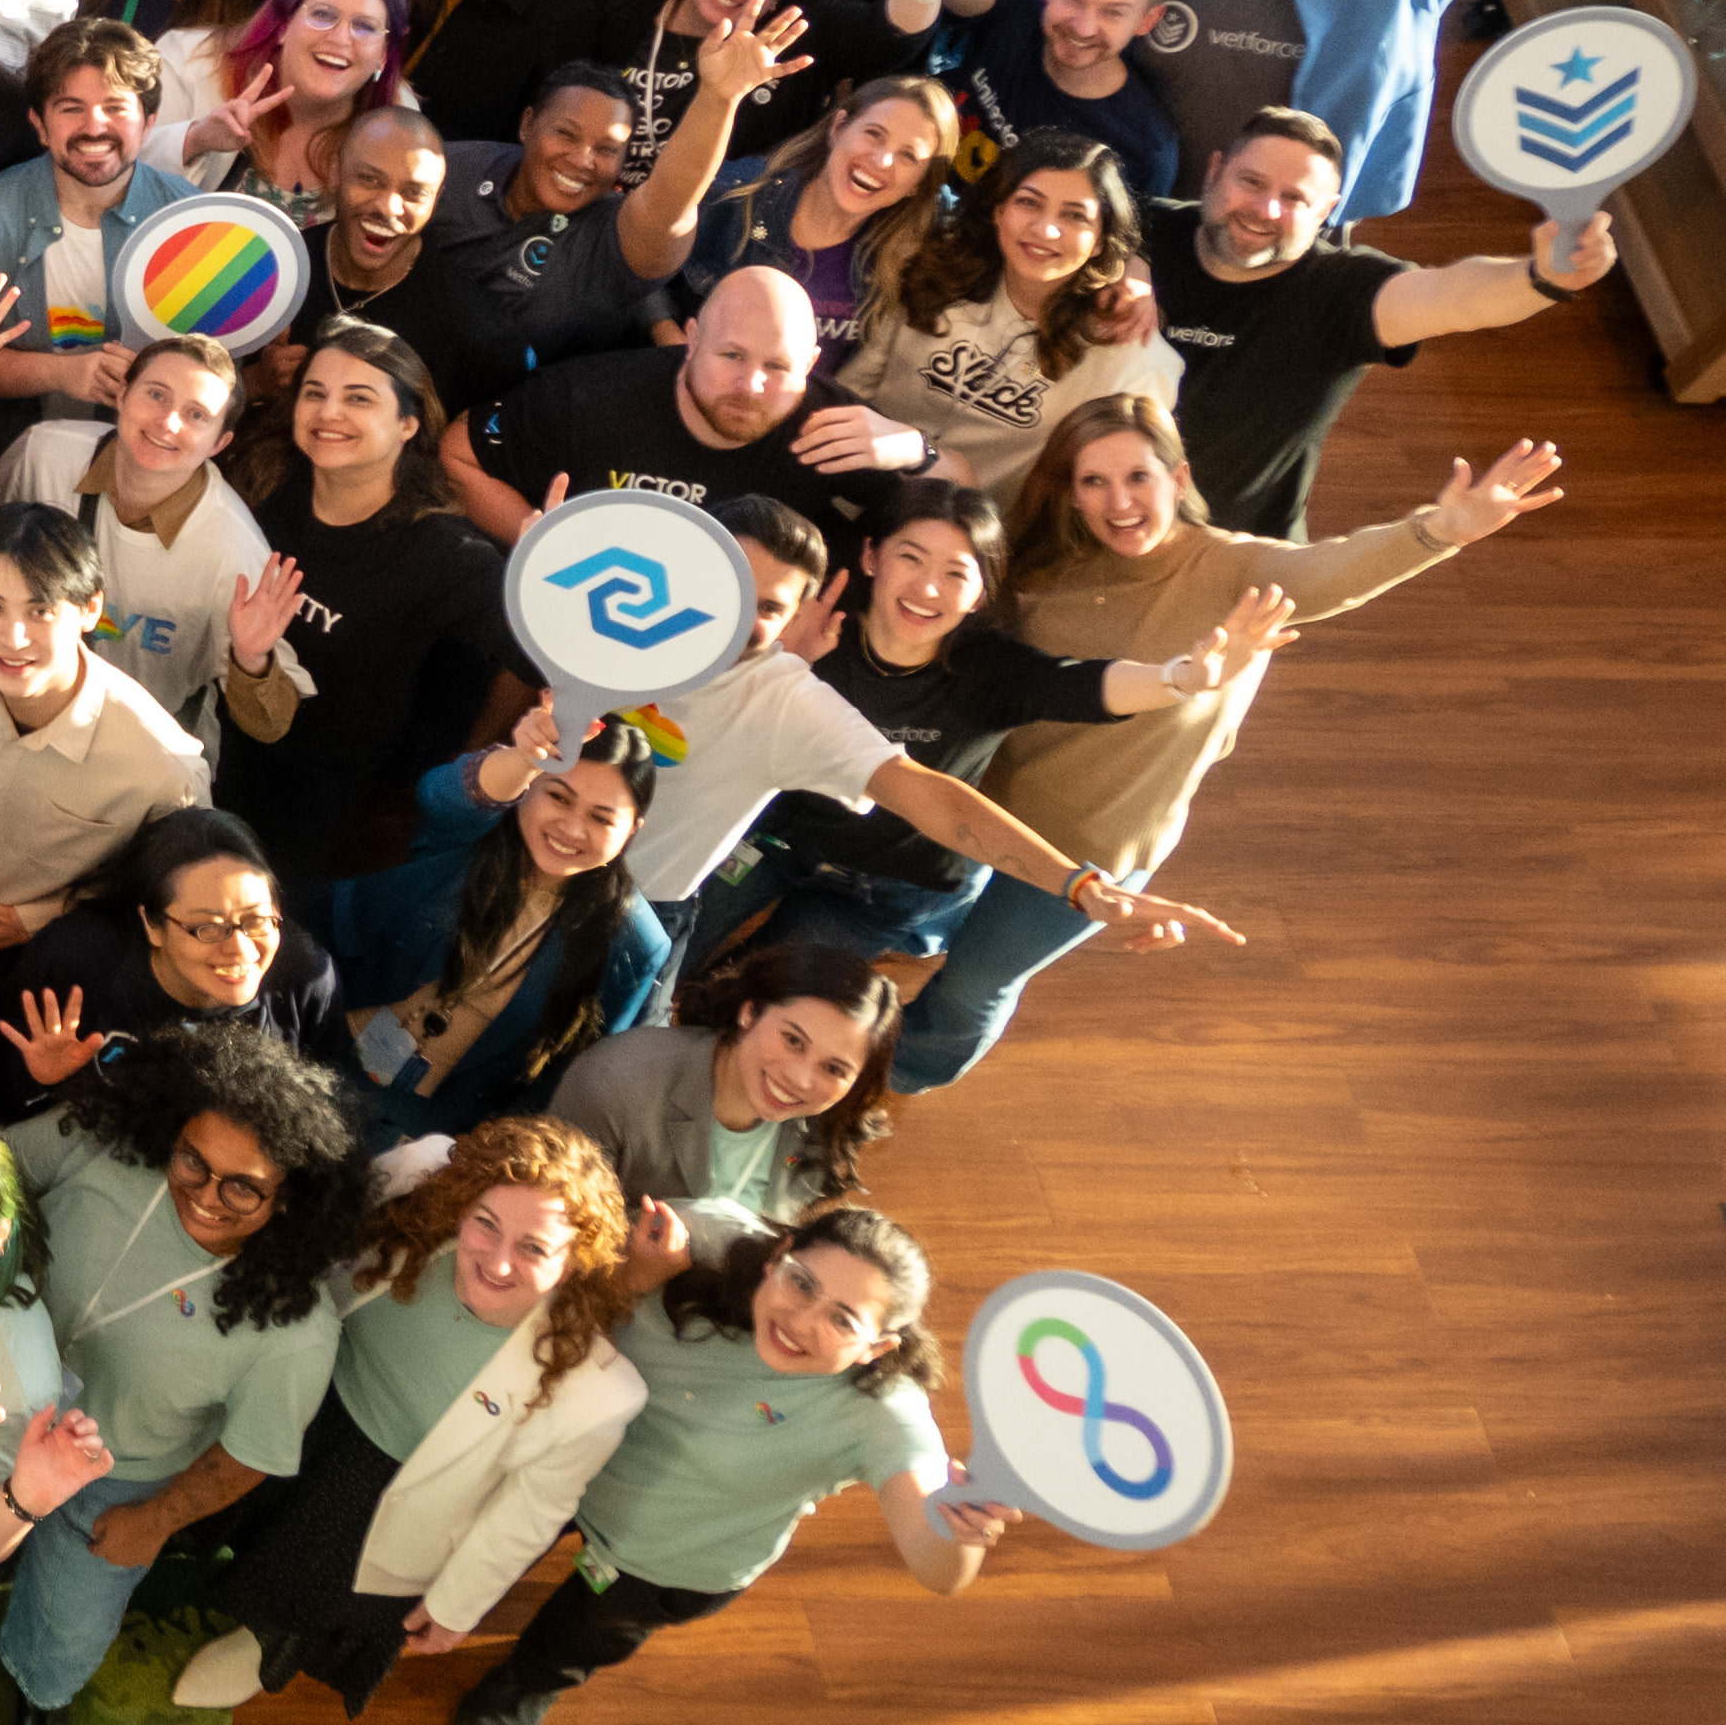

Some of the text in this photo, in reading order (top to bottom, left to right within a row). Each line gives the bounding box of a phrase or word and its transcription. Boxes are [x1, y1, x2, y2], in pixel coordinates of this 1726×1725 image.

[1207, 28, 1306, 60] vetforce
[922, 339, 1051, 428] Slack
[609, 469, 708, 506] VICTOR
